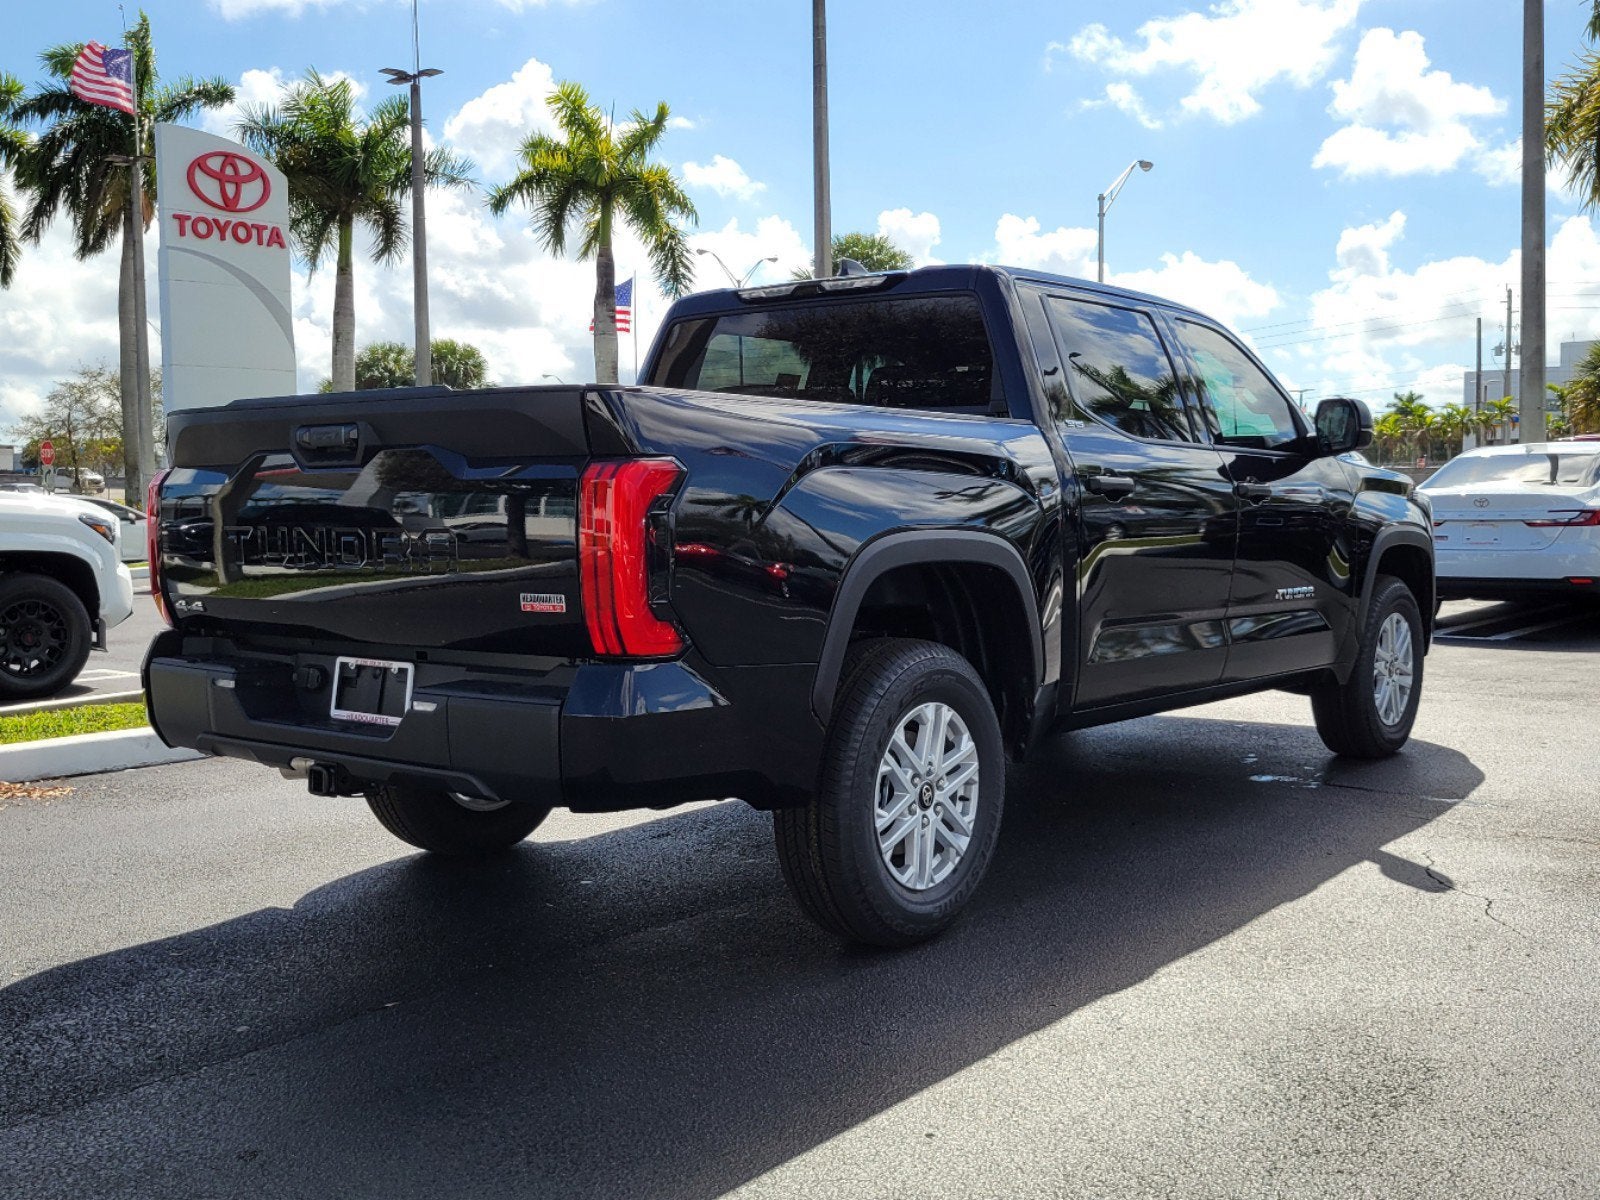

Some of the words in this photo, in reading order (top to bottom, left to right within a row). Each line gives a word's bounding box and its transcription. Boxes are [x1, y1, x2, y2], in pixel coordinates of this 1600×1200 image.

[172, 213, 287, 249] TOYOTA
[41, 448, 55, 458] STOP
[222, 525, 460, 572] TUNDRA
[521, 594, 565, 604] HEADQUARTER
